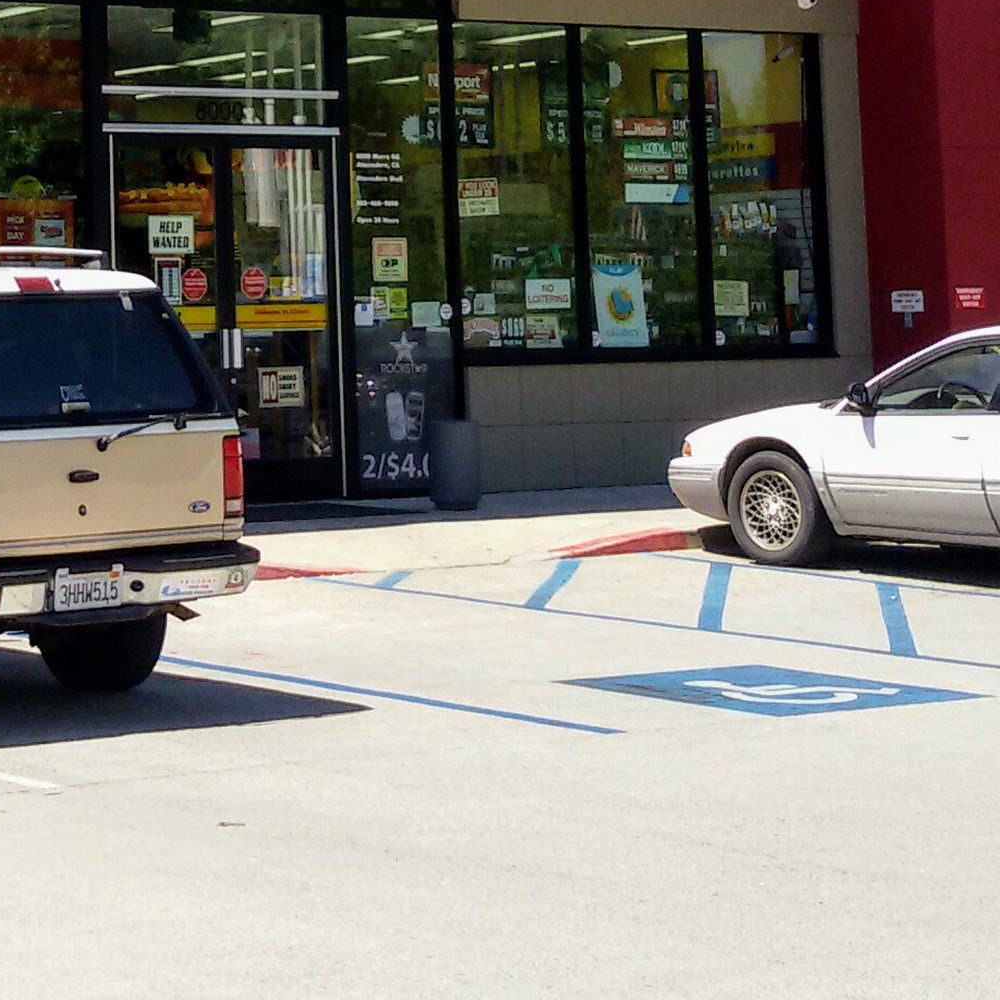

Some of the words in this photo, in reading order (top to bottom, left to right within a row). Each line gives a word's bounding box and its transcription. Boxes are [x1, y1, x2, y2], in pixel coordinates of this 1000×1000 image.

[428, 73, 481, 91] Nport
[159, 221, 182, 233] HELP
[152, 235, 189, 249] WANTED
[541, 284, 554, 293] NO
[528, 294, 568, 304] LOITERING
[60, 580, 119, 607] 3HHW515
